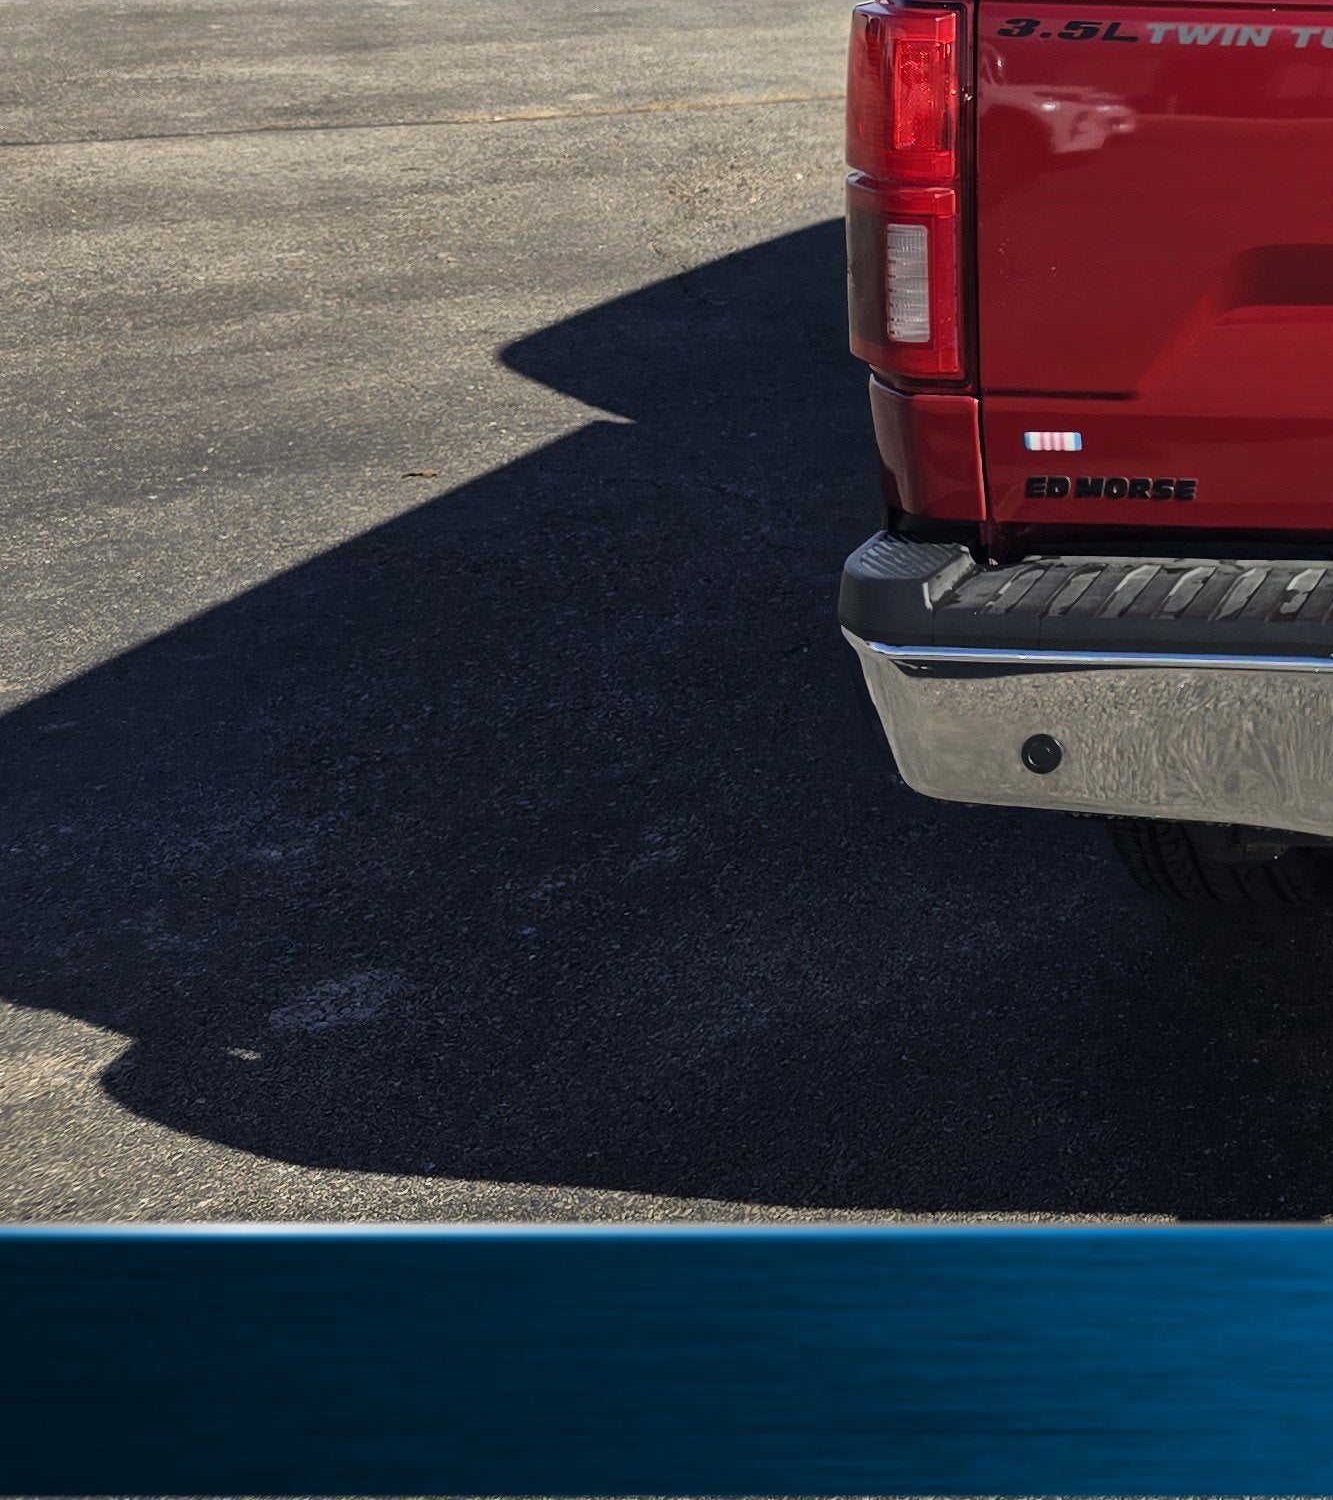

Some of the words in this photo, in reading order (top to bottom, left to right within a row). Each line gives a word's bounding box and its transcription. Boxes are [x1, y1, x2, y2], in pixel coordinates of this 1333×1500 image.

[996, 17, 1139, 44] 3.5L
[1145, 21, 1274, 49] TWIN
[1025, 476, 1071, 499] ED
[1074, 477, 1198, 502] MORSE
